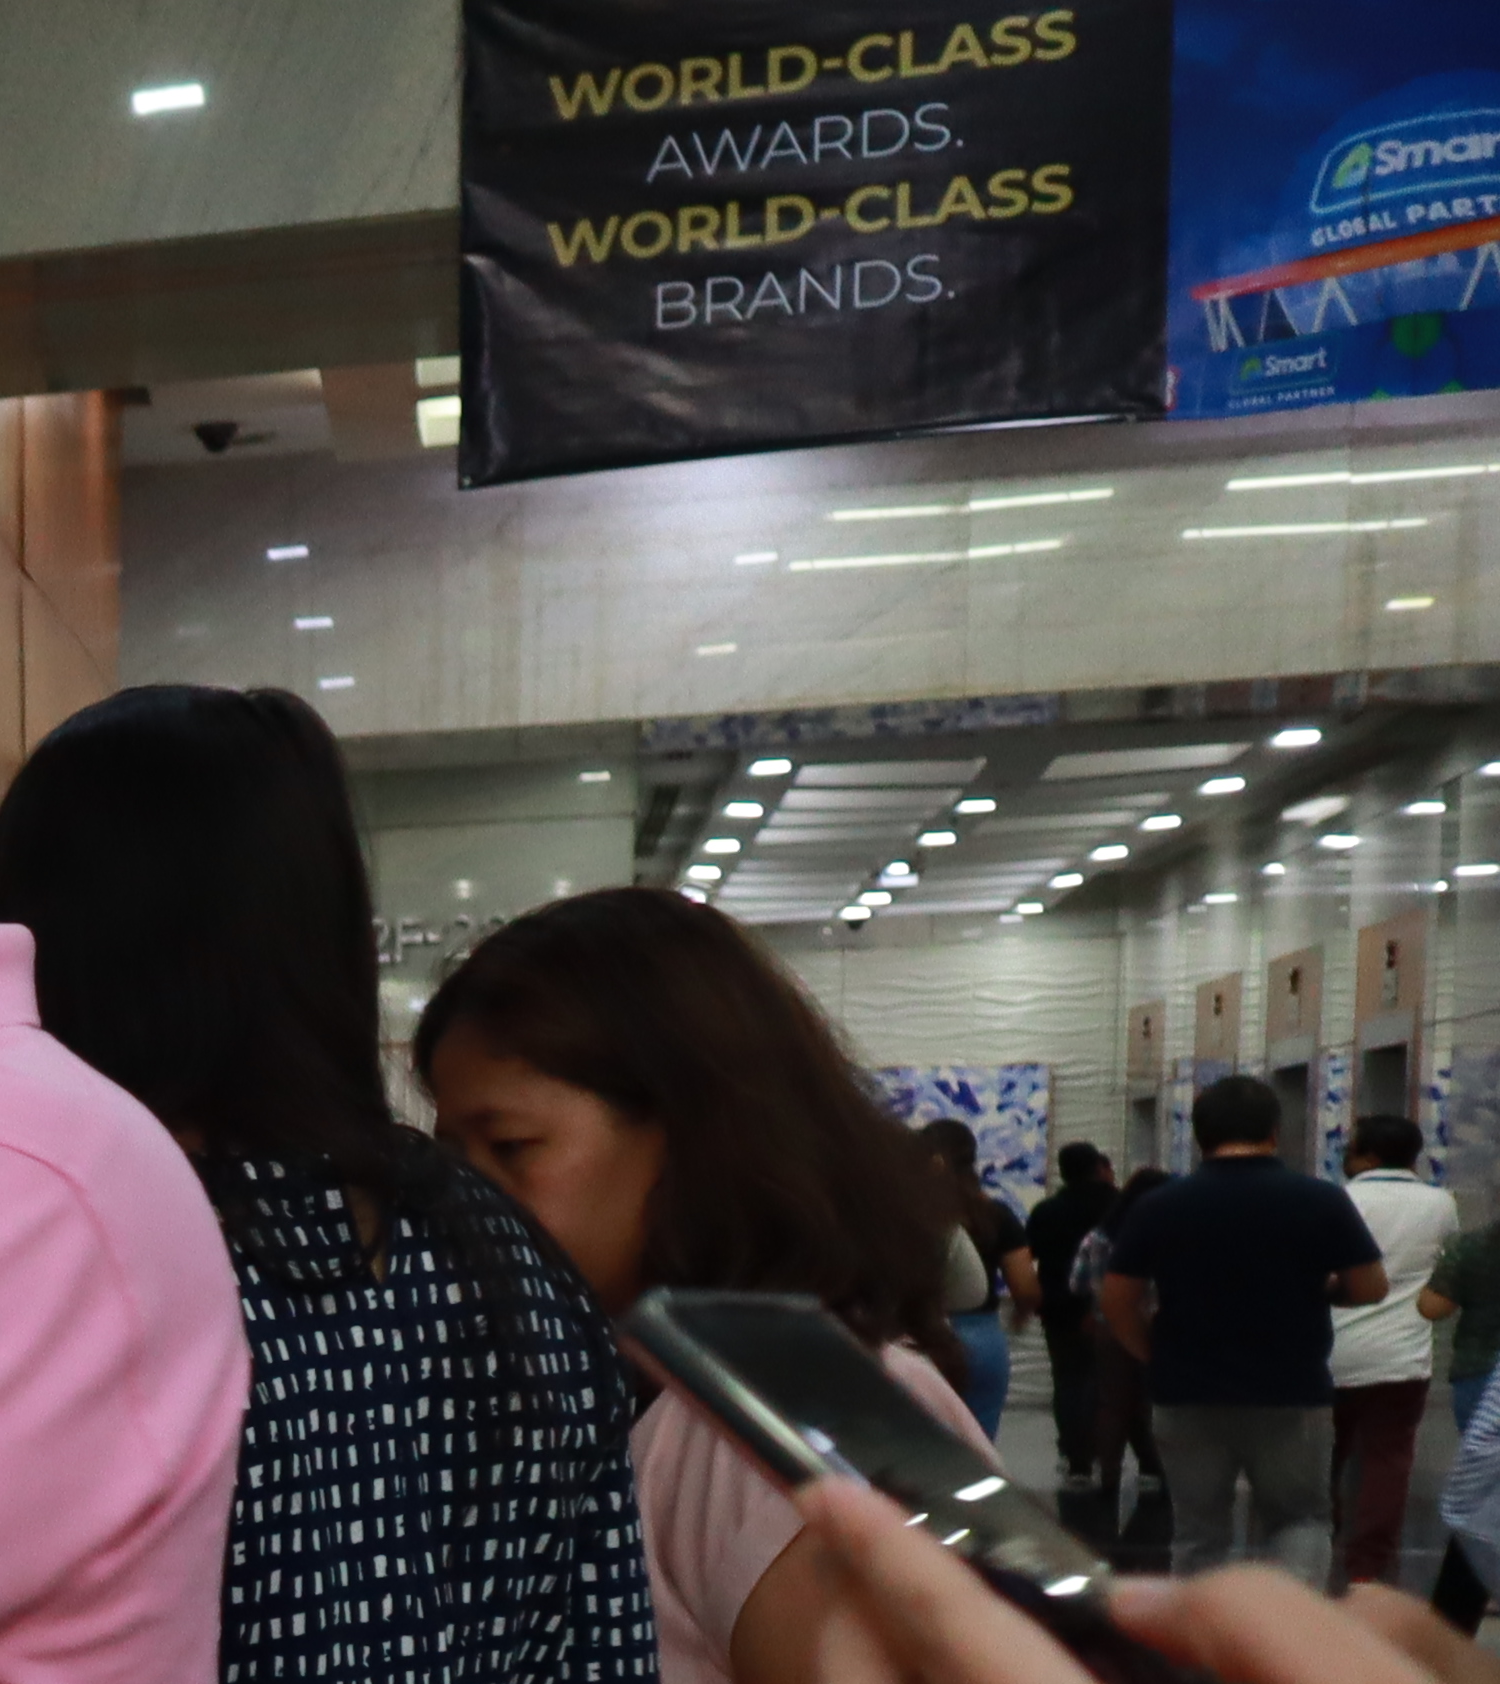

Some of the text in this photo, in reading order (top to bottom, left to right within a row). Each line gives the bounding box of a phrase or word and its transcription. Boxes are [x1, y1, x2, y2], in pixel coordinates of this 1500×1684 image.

[550, 10, 1077, 121] WORLD-CLASS
[647, 102, 965, 183] AWARDS.
[548, 165, 1073, 267] WORLD-CLASS
[1310, 211, 1398, 247] GLOBAL
[655, 254, 955, 332] BRANDS.
[1264, 346, 1327, 378] Smart
